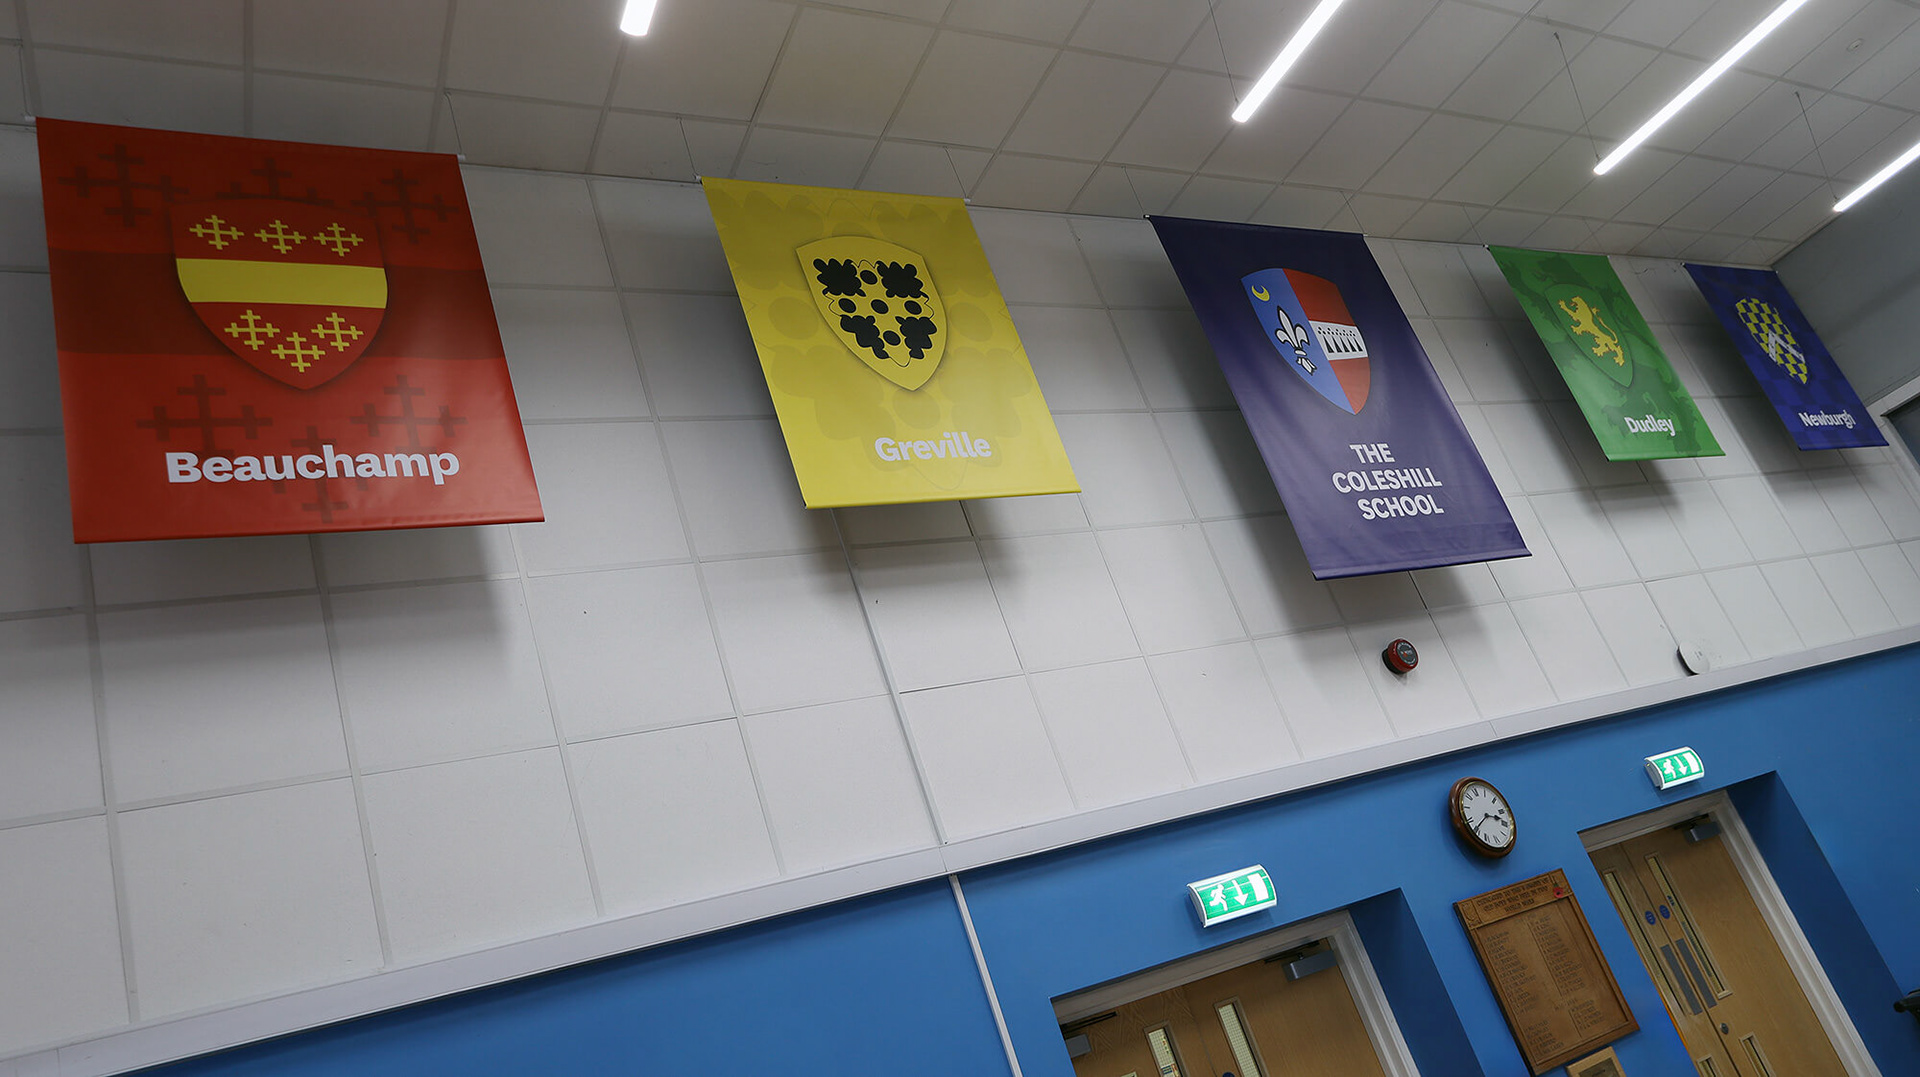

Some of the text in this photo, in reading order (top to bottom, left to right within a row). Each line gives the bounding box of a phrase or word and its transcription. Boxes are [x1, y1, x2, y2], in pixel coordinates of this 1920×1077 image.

[1624, 414, 1676, 437] Dudley
[1798, 409, 1857, 429] Newburgh
[874, 431, 992, 462] Greville
[1349, 443, 1396, 464] THE
[165, 444, 460, 486] Beauchamp
[1332, 467, 1443, 494] COLESHILL
[1357, 494, 1445, 520] SCHOOL
